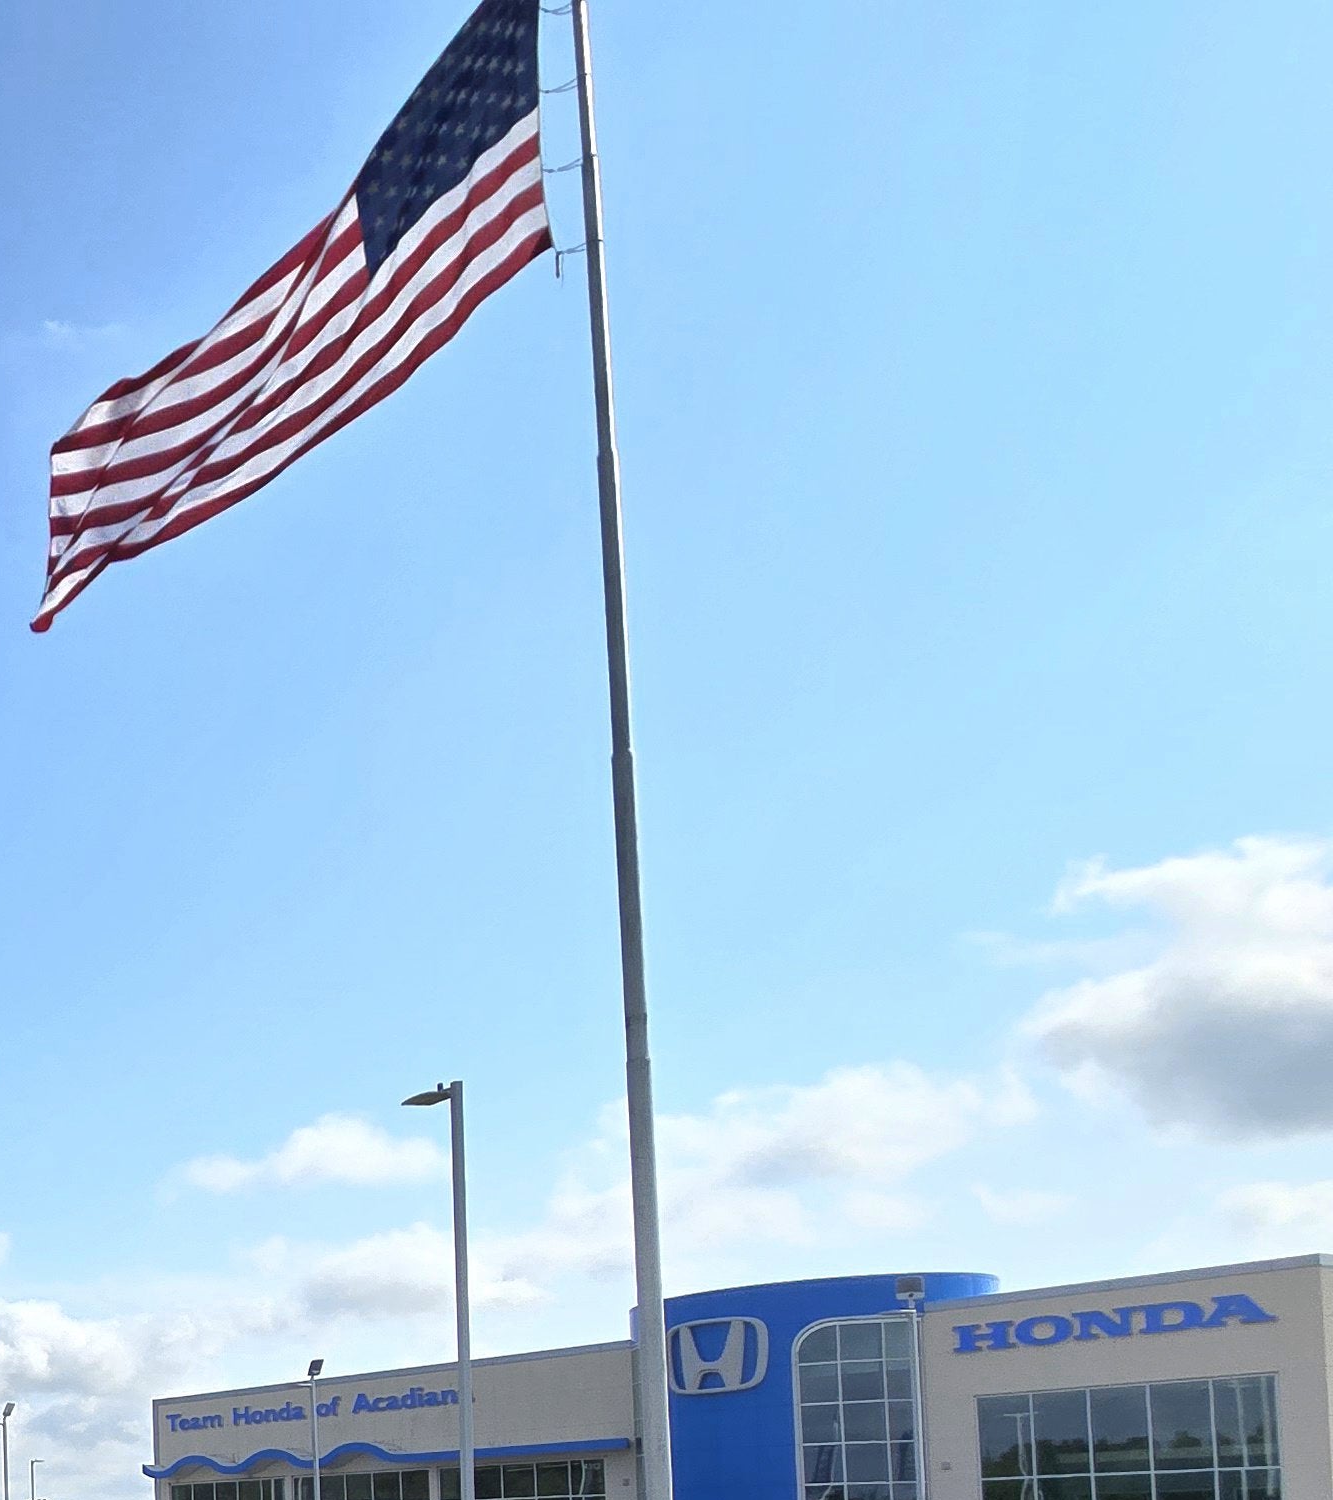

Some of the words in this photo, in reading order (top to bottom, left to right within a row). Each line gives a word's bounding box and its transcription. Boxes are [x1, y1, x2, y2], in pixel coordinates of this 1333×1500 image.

[952, 1293, 1277, 1354] HONDA
[165, 1413, 224, 1432] Team
[232, 1401, 309, 1426] Honda
[315, 1395, 342, 1417] of
[351, 1386, 475, 1415] Acadian
